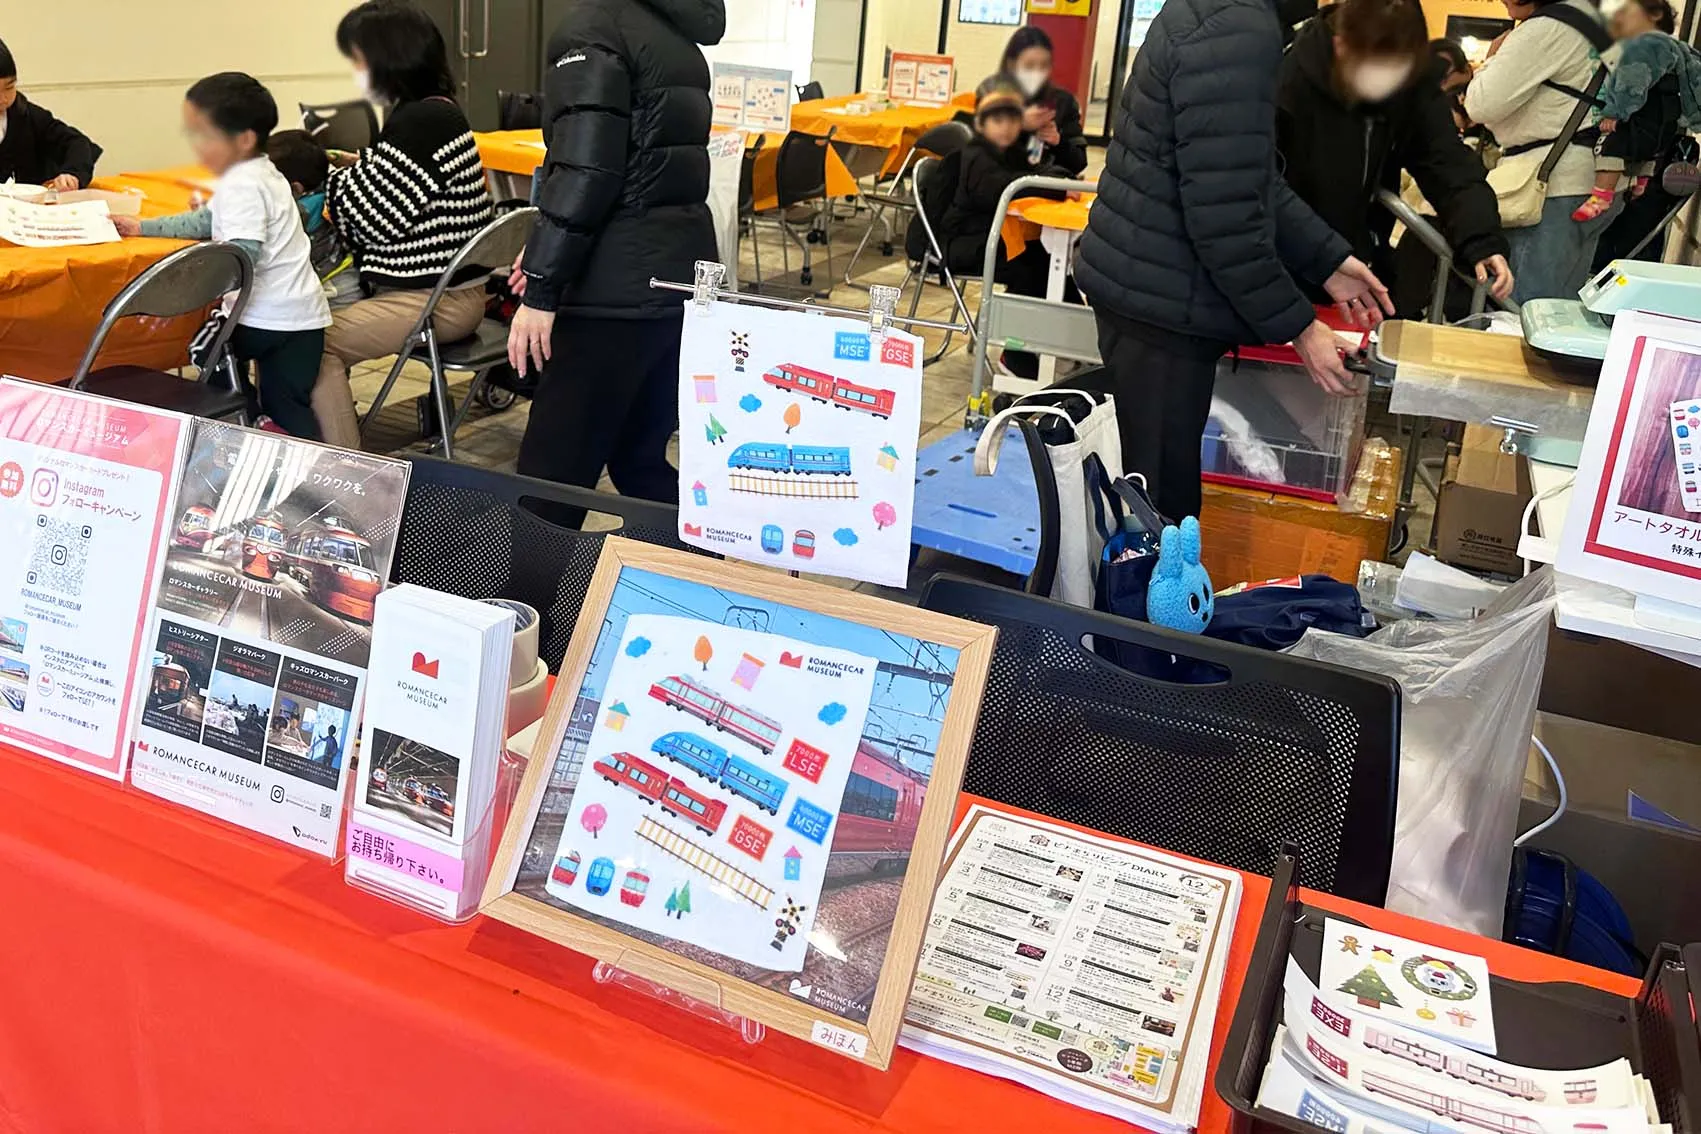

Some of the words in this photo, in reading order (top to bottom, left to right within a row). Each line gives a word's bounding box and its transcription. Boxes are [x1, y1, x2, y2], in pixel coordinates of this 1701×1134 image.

[840, 345, 864, 357] MSE
[886, 349, 910, 363] GSE
[63, 478, 105, 499] Instagram
[62, 494, 142, 521] フォローキャンペーン
[706, 528, 752, 541] ROMANCECAR
[1614, 511, 1701, 541] アートタオル
[706, 534, 735, 543] MUSEUM
[239, 581, 282, 599] MUSEUM
[807, 665, 842, 678] MUSEUM
[809, 657, 864, 675] ROMANCECAR
[397, 680, 448, 704] ROMANCECAR
[406, 693, 439, 710] MUSEUM
[151, 746, 217, 777] ROMANCECAR
[219, 771, 261, 792] MUSEUM
[790, 754, 818, 776] LSE
[794, 814, 821, 838] MSE
[352, 829, 395, 853] ご自由に
[735, 830, 762, 853] GSE
[350, 840, 445, 884] お持ち帰り下さい。
[1131, 864, 1168, 879] DIARY
[1186, 877, 1205, 889] 12
[814, 996, 846, 1013] MUSEUM
[815, 987, 867, 1012] ROMANCECAR
[820, 1027, 859, 1053] みほん
